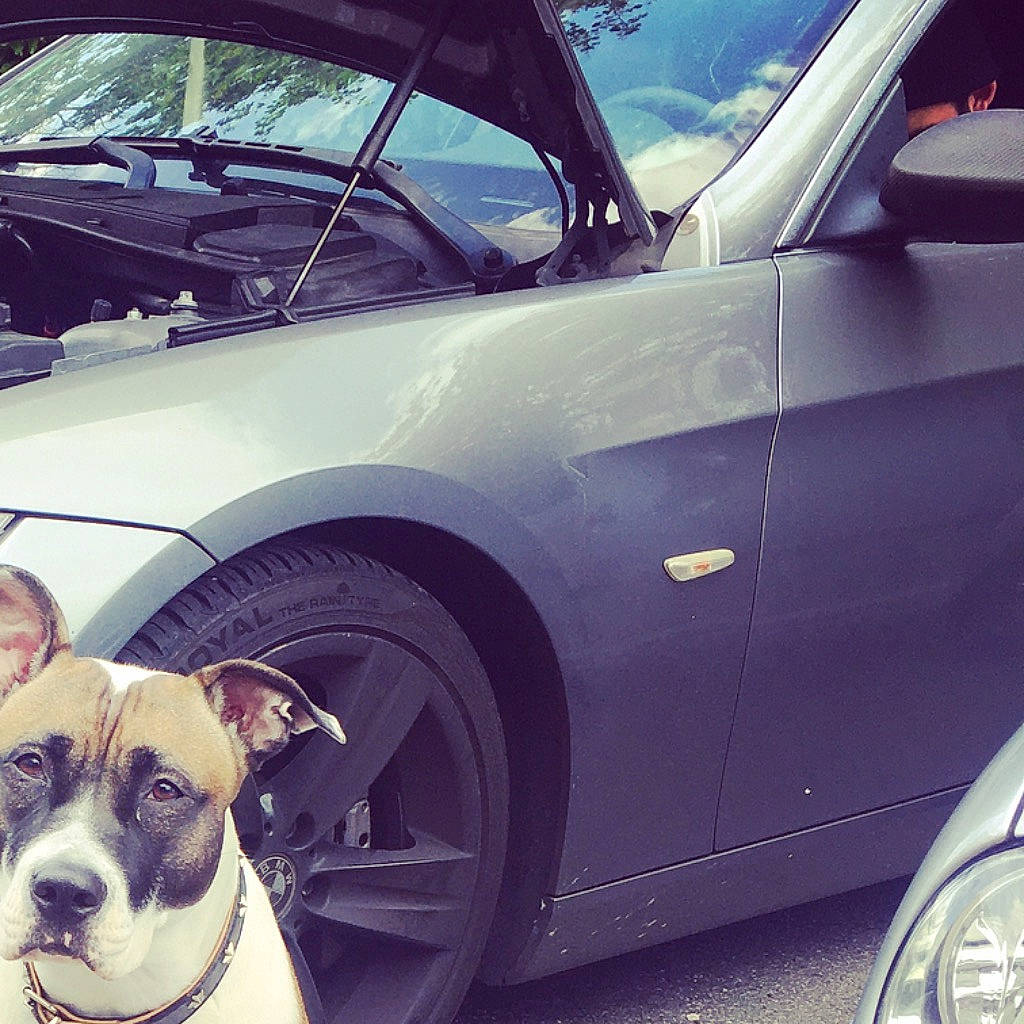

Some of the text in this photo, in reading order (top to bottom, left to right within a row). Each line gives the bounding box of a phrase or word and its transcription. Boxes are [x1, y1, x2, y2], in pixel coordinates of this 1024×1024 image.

[278, 601, 306, 617] THE
[309, 595, 341, 609] RAIN
[259, 859, 293, 885] BMW
